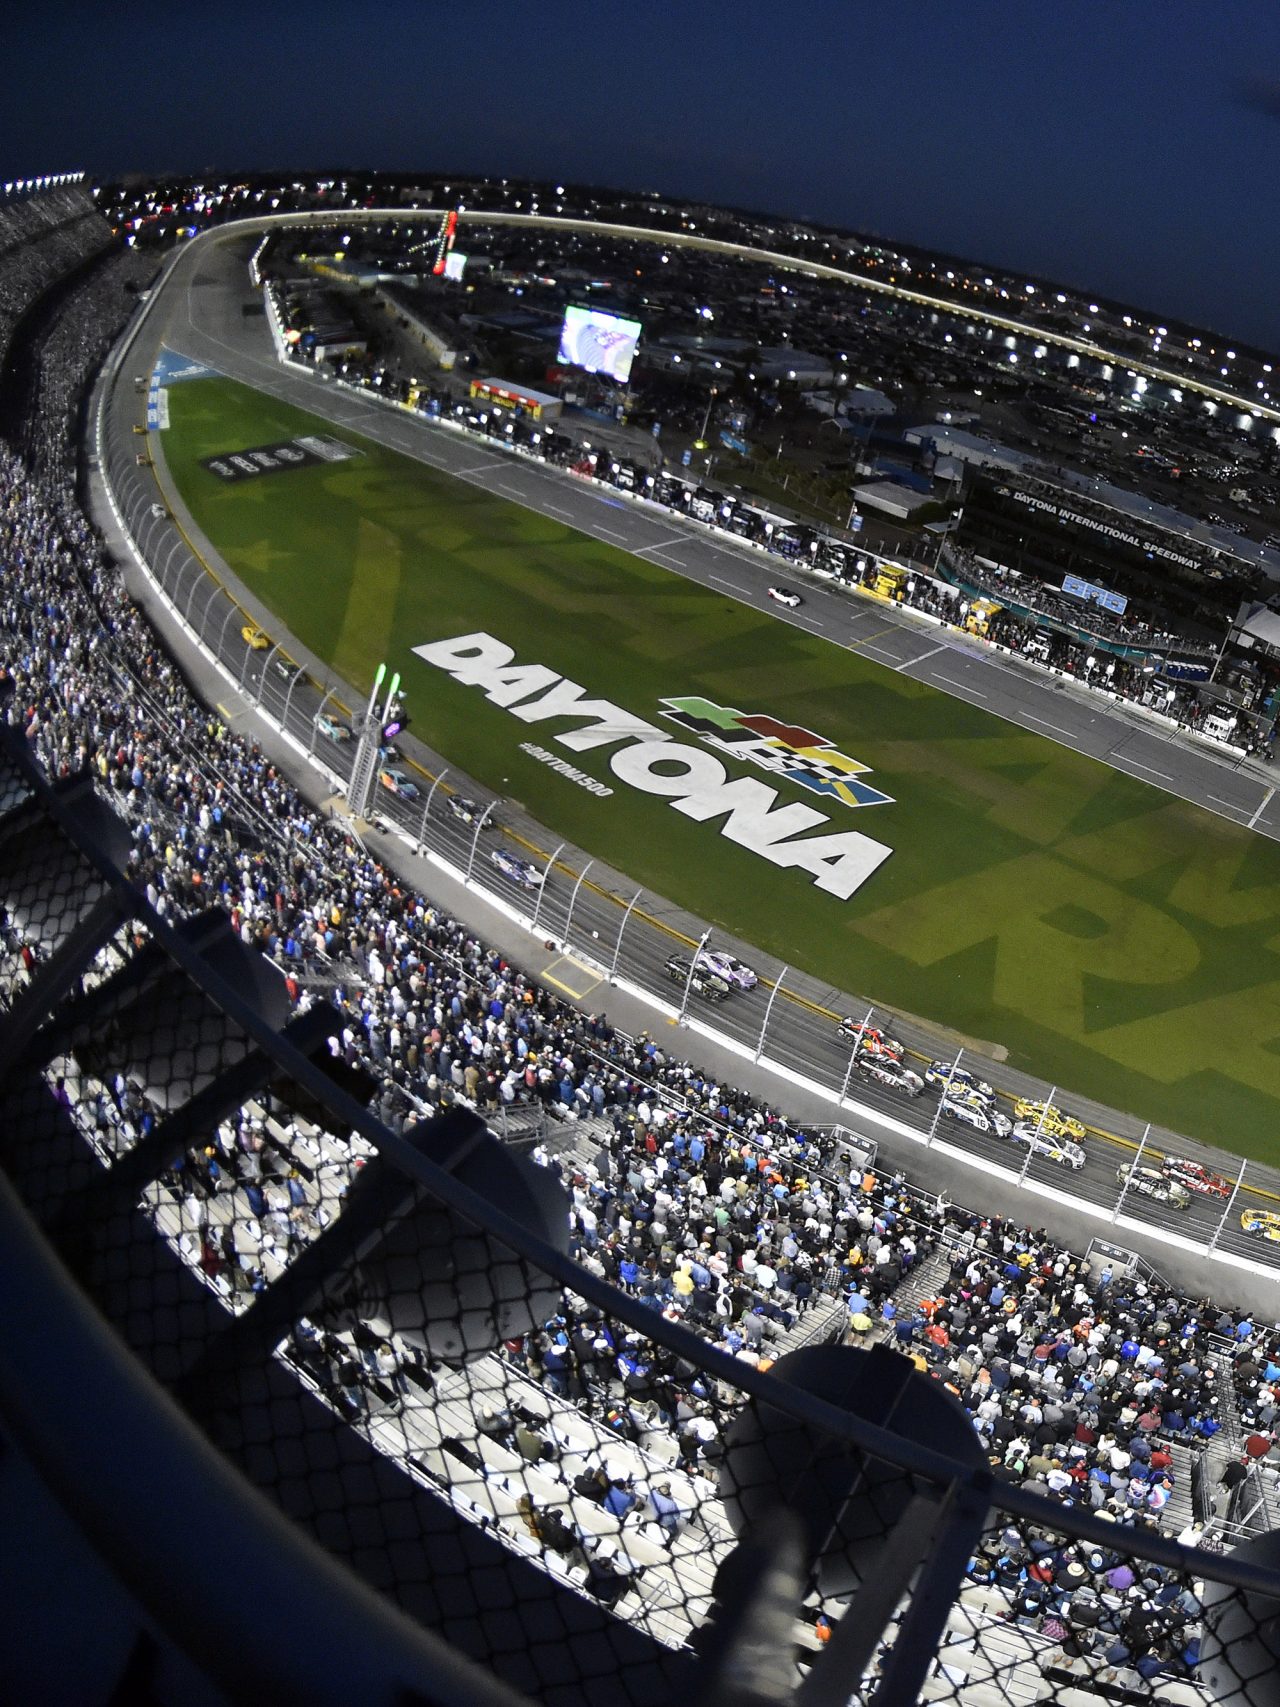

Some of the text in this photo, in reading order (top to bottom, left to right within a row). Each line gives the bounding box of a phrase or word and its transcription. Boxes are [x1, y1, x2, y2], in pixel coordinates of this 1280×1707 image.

[1013, 491, 1202, 571] DAYTONA INTERNATIONAL SPEEDWAY
[411, 631, 894, 900] DAYTONA
[518, 741, 614, 798] #DAYTONA500
[976, 1117, 987, 1129] 16
